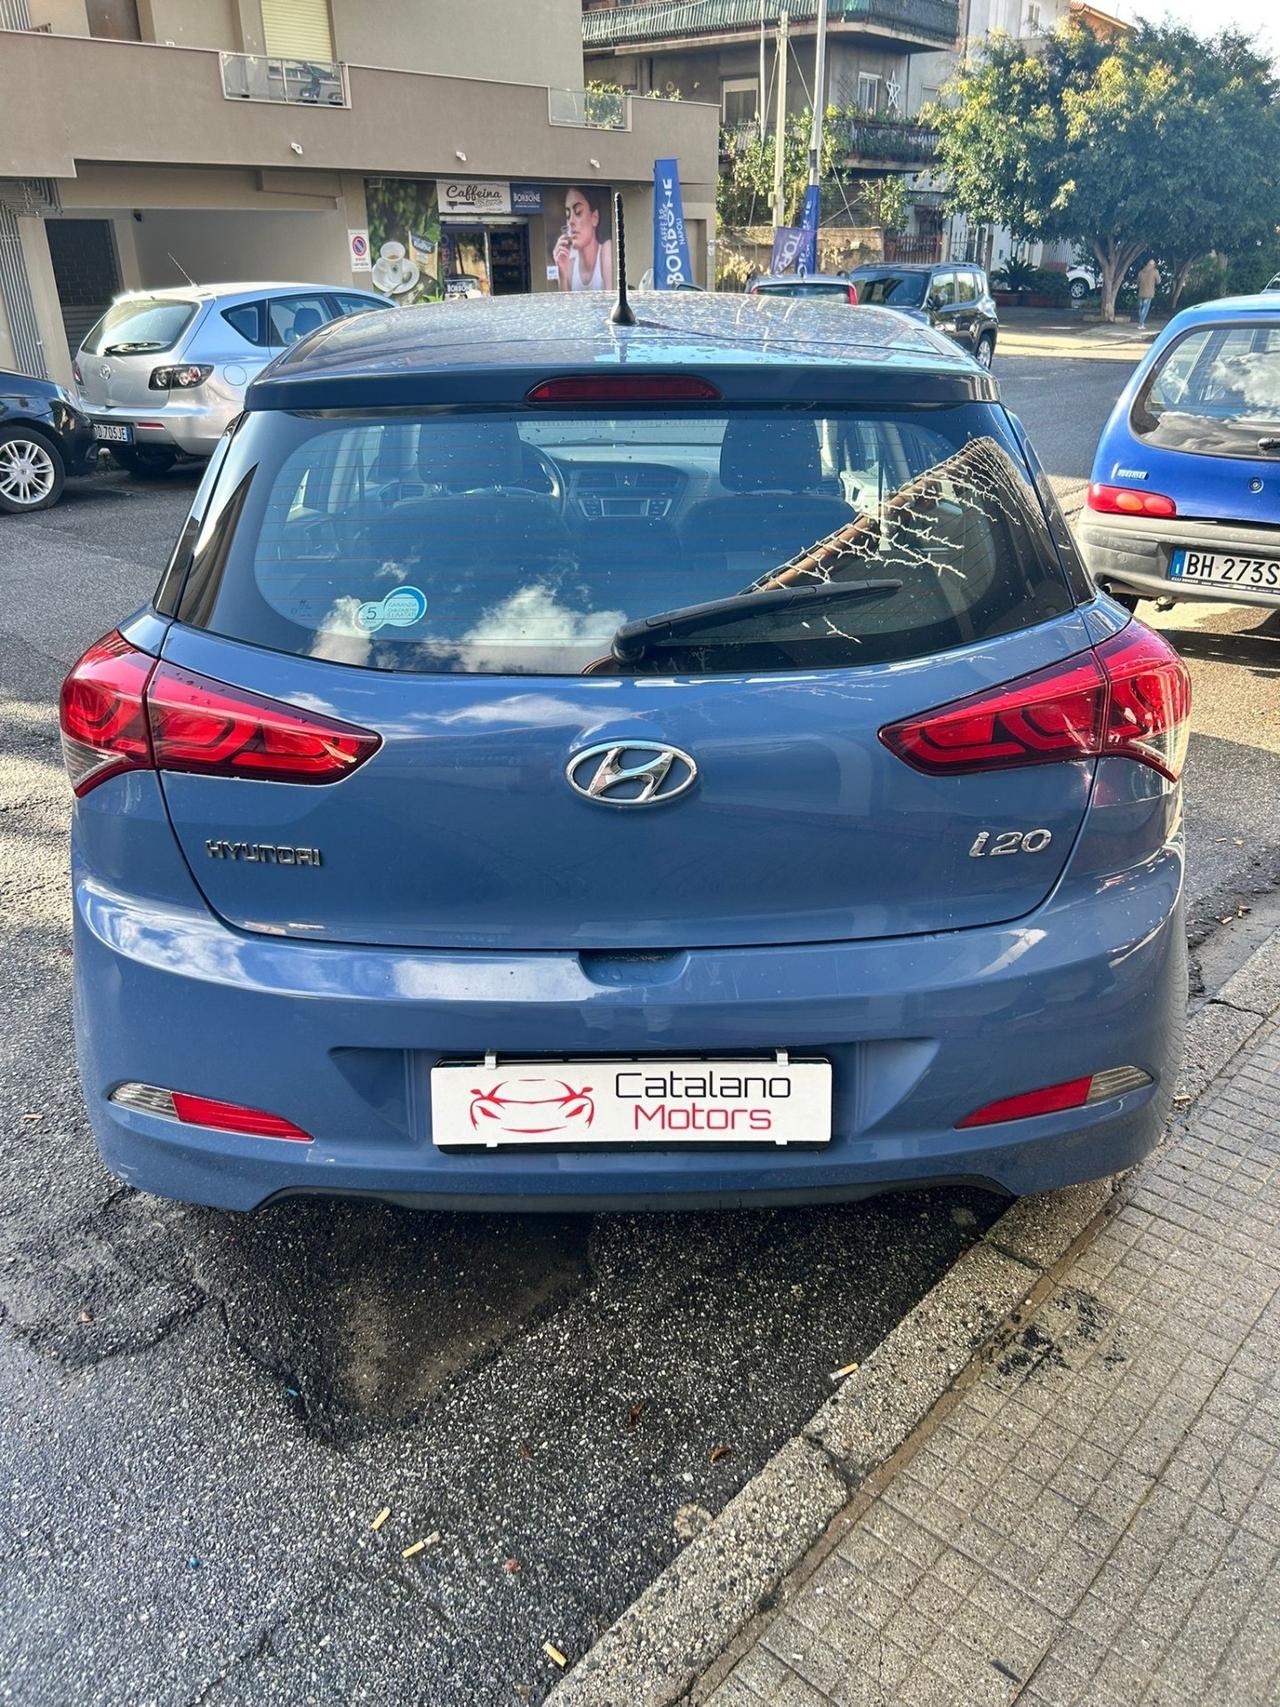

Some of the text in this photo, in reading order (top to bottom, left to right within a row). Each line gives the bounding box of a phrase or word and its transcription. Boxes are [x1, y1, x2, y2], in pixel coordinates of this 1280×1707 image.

[446, 184, 502, 201] Caffeina
[513, 192, 541, 202] BORBONE
[676, 217, 686, 246] NAPOLI
[1187, 554, 1215, 578] BH
[366, 607, 377, 620] 5
[205, 840, 321, 867] HYUNDAI
[969, 829, 1052, 858] i20
[615, 1071, 792, 1098] Catalano
[634, 1103, 772, 1130] Motors
